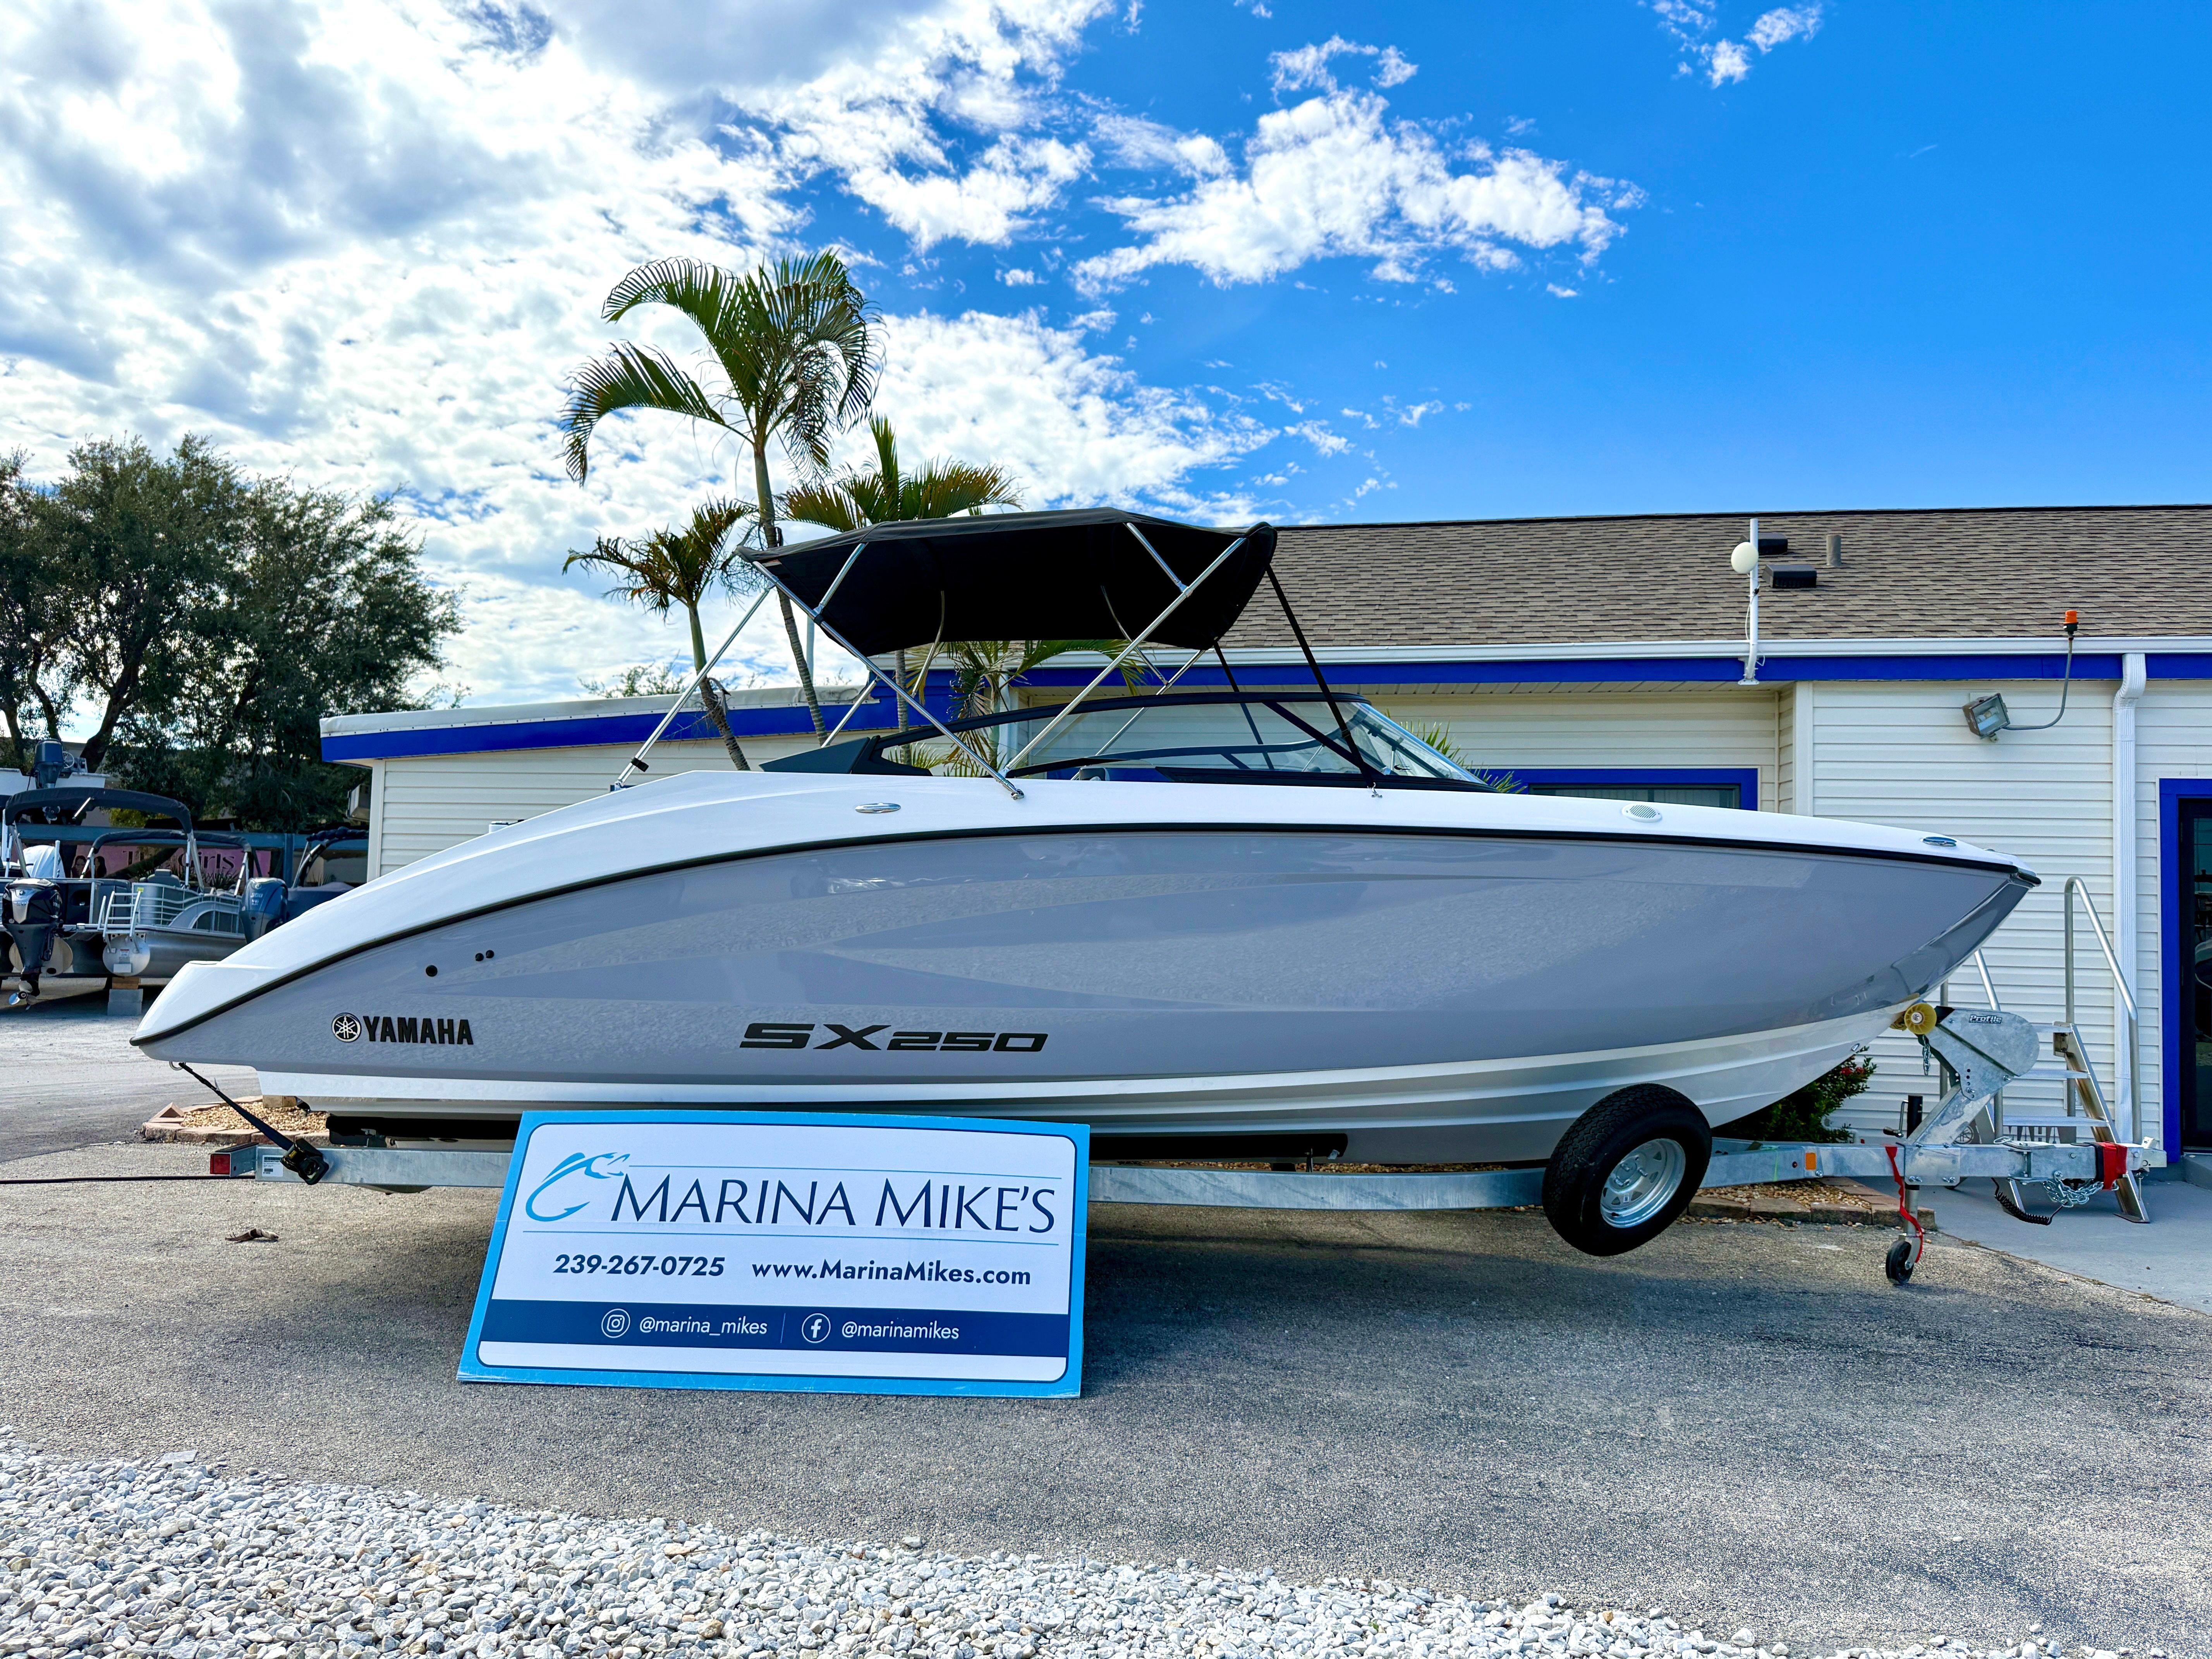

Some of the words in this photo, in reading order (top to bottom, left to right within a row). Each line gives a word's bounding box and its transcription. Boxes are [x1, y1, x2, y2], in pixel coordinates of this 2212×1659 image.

[363, 1015, 474, 1045] YAMAHA
[739, 1023, 1049, 1052] SX250
[611, 1173, 856, 1225] MARINA
[875, 1178, 1055, 1233] MIKE'S
[553, 1254, 725, 1276] 239-267-0725
[752, 1258, 1031, 1285] www.MarinaMikes.com
[639, 1316, 768, 1336] @marina_mikes
[841, 1320, 960, 1340] @marinamikes
